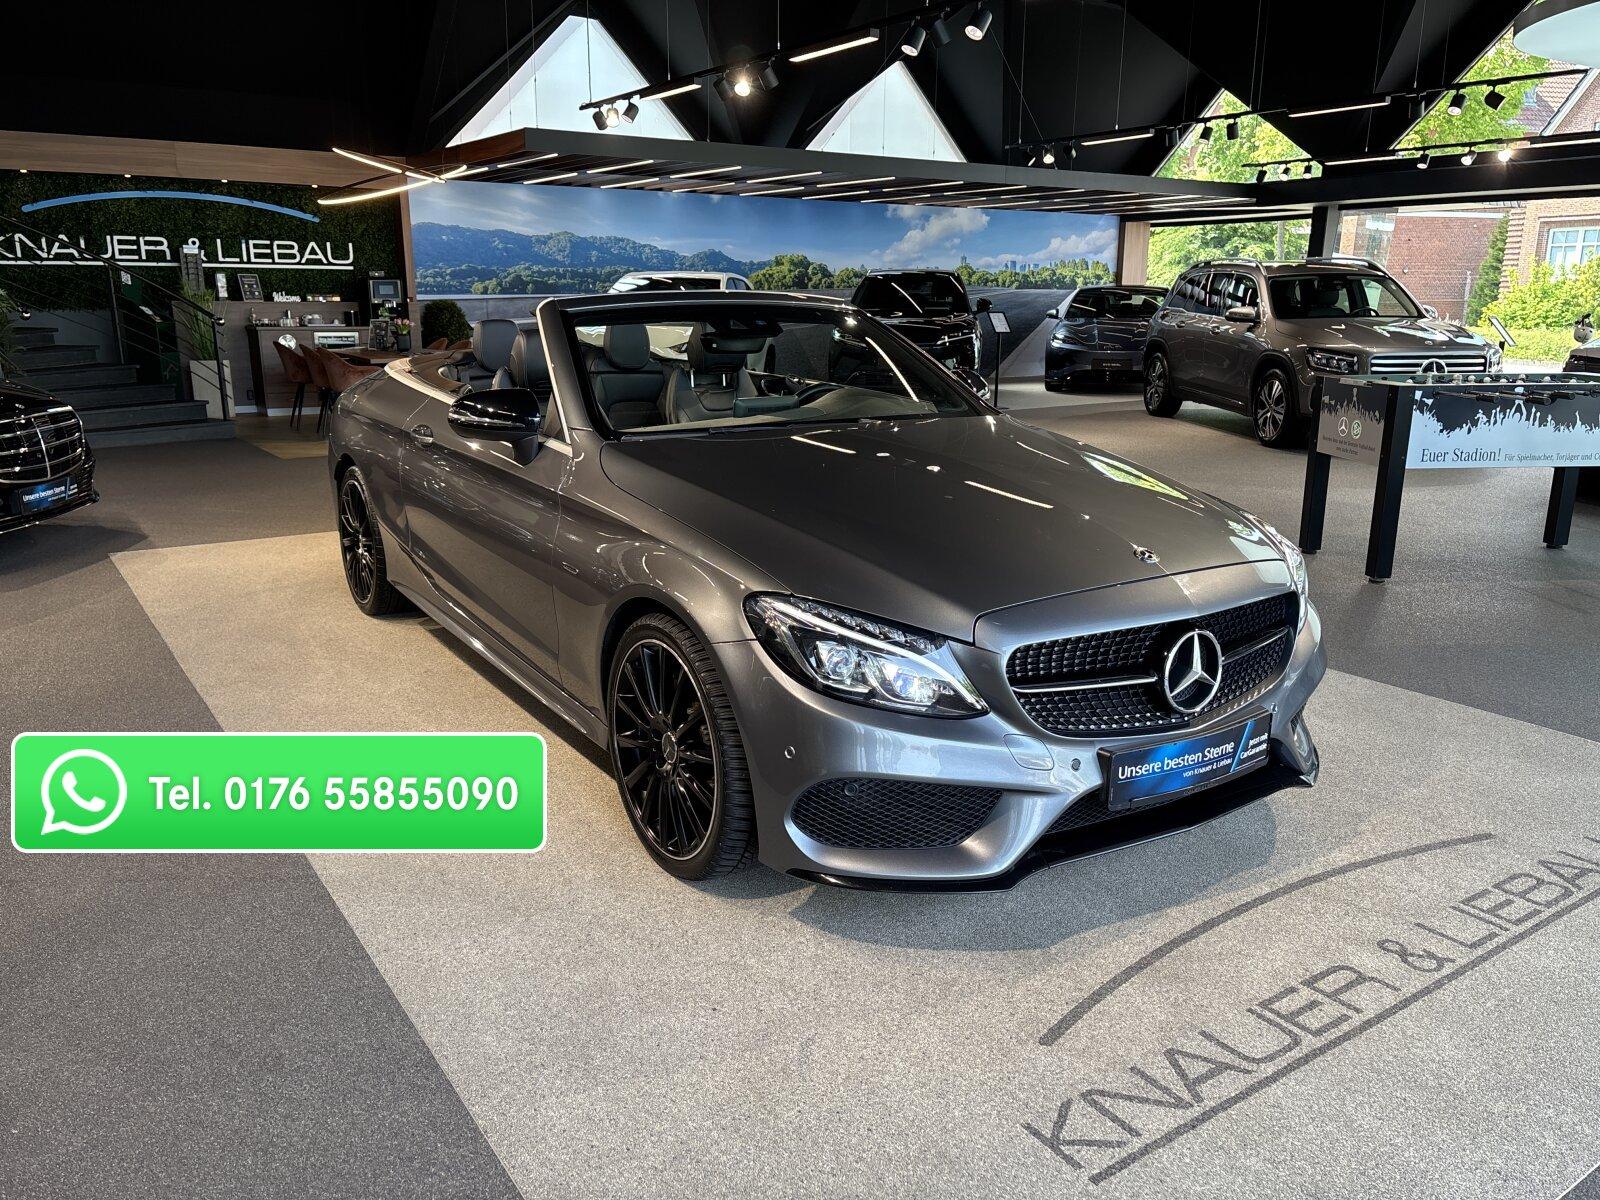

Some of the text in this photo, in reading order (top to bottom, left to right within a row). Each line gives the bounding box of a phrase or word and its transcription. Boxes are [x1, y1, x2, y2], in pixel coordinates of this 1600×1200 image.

[216, 238, 354, 265] LIEBAU
[1420, 448, 1449, 463] Euer
[1452, 447, 1502, 462] Stadion!
[1504, 453, 1516, 461] Für
[1118, 741, 1235, 780] Unsere besten Sterne
[1182, 769, 1194, 778] von
[1194, 763, 1213, 775] Knauer
[1021, 964, 1401, 1170] KNAUER
[1376, 938, 1455, 973] &
